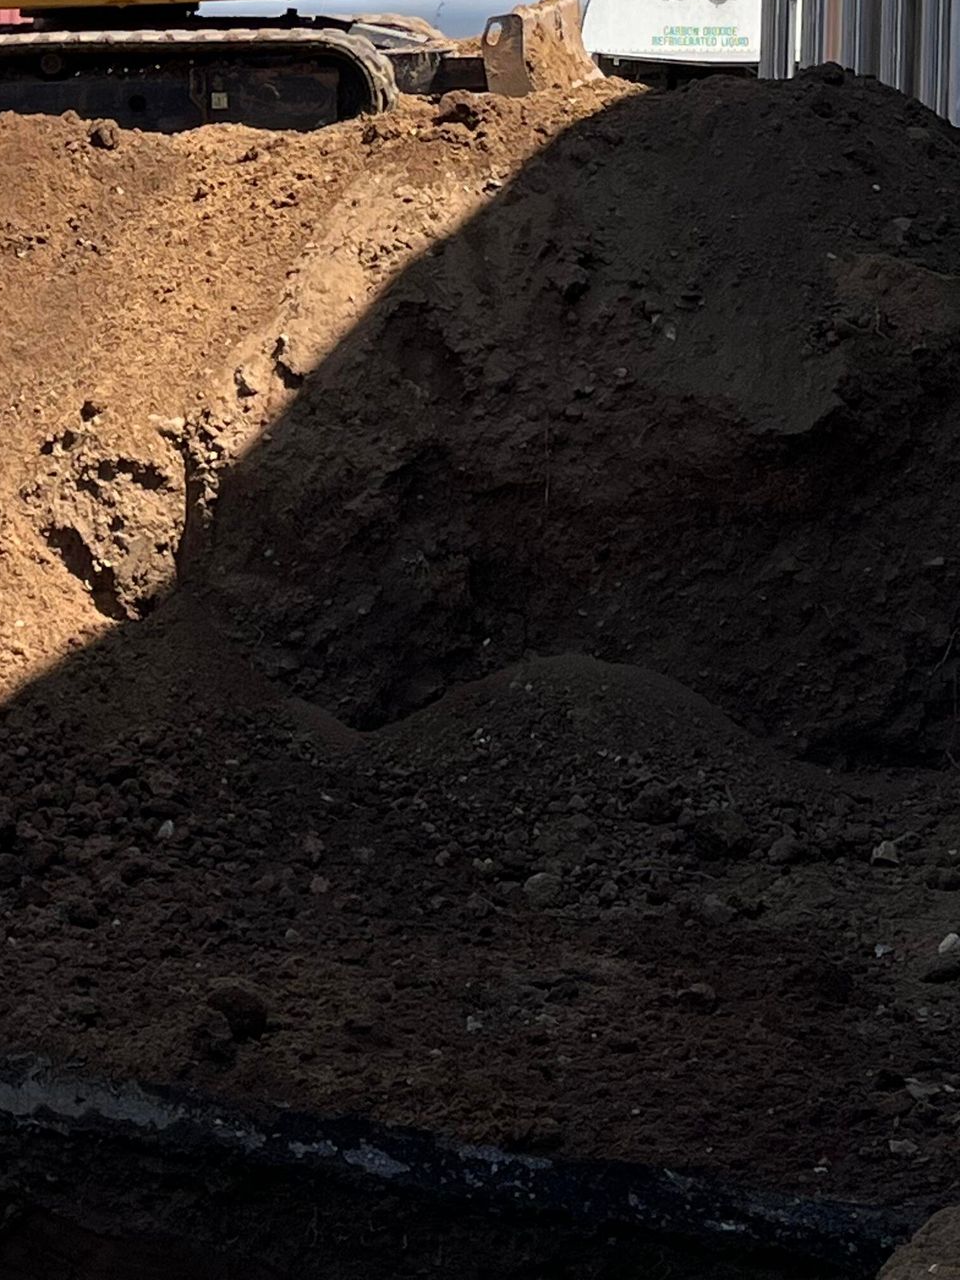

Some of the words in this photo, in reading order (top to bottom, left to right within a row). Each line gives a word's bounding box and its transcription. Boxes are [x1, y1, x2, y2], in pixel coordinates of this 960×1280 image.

[663, 26, 700, 36] CARBON
[651, 36, 718, 47] REFRIGERATED
[721, 36, 750, 48] LIQUID
